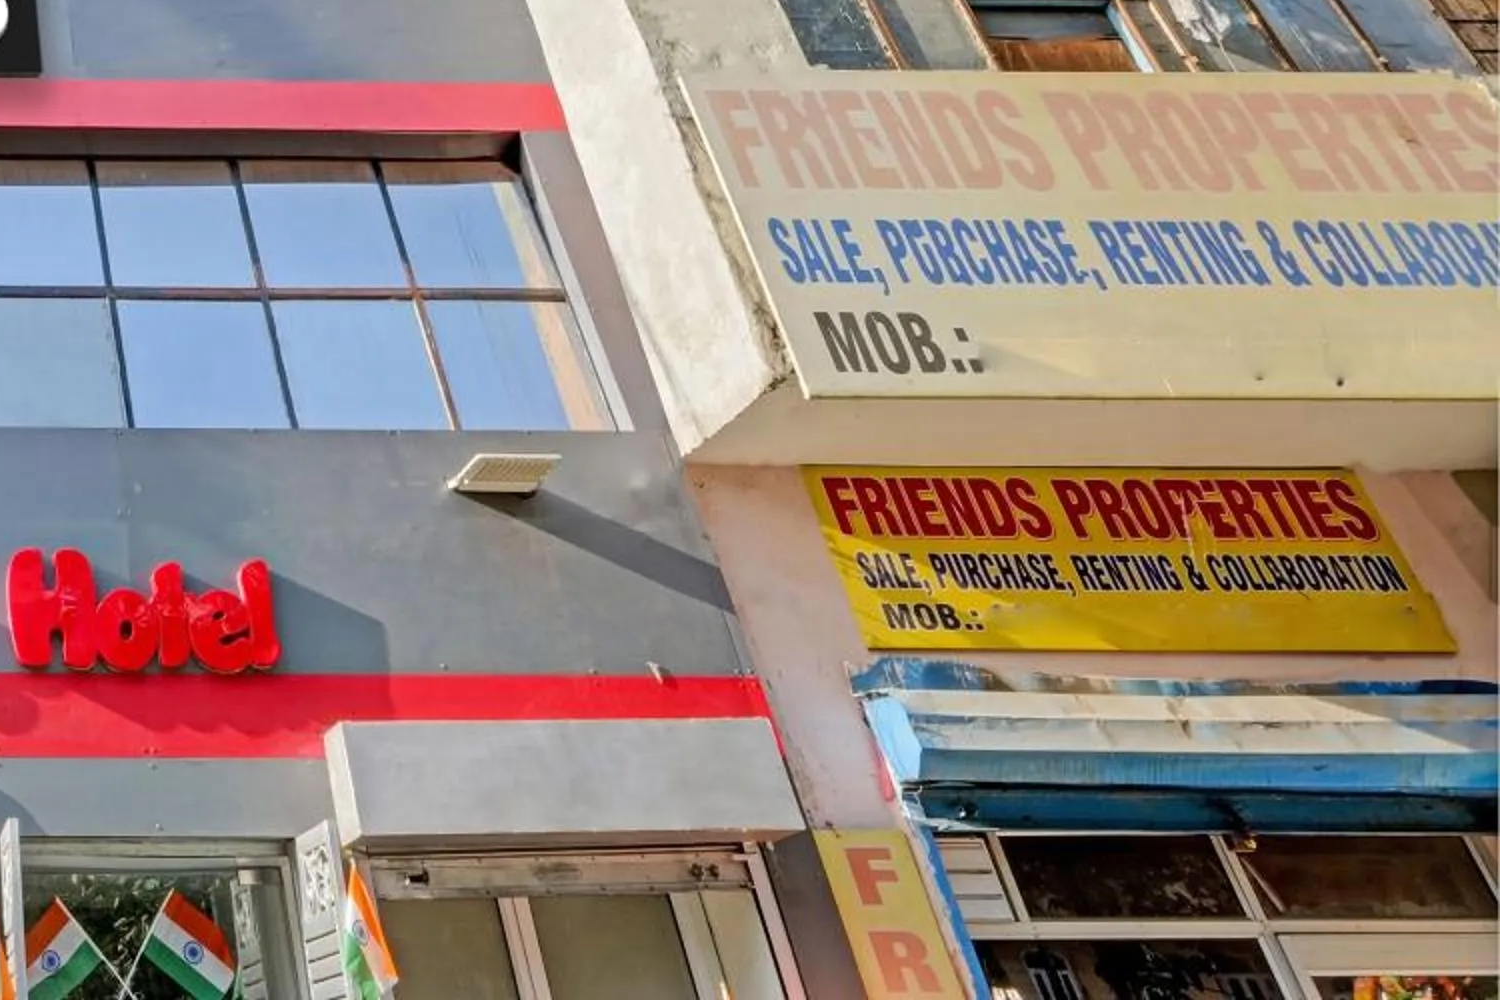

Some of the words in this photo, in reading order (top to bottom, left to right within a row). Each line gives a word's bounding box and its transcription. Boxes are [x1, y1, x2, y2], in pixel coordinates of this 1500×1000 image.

[705, 89, 1056, 191] FRIENDS
[767, 216, 890, 296] SALE,
[1087, 220, 1272, 286] RENTING
[1255, 219, 1312, 287] &
[820, 476, 1054, 539] FRIENDS
[1050, 478, 1380, 541] PROPERTIES
[5, 546, 284, 674] Hotel
[855, 551, 934, 596] SALE,
[927, 551, 1078, 597] PURCHASE,
[1069, 554, 1184, 592] RENTING
[1180, 554, 1211, 592] &
[1204, 554, 1410, 593] COLLABORATION
